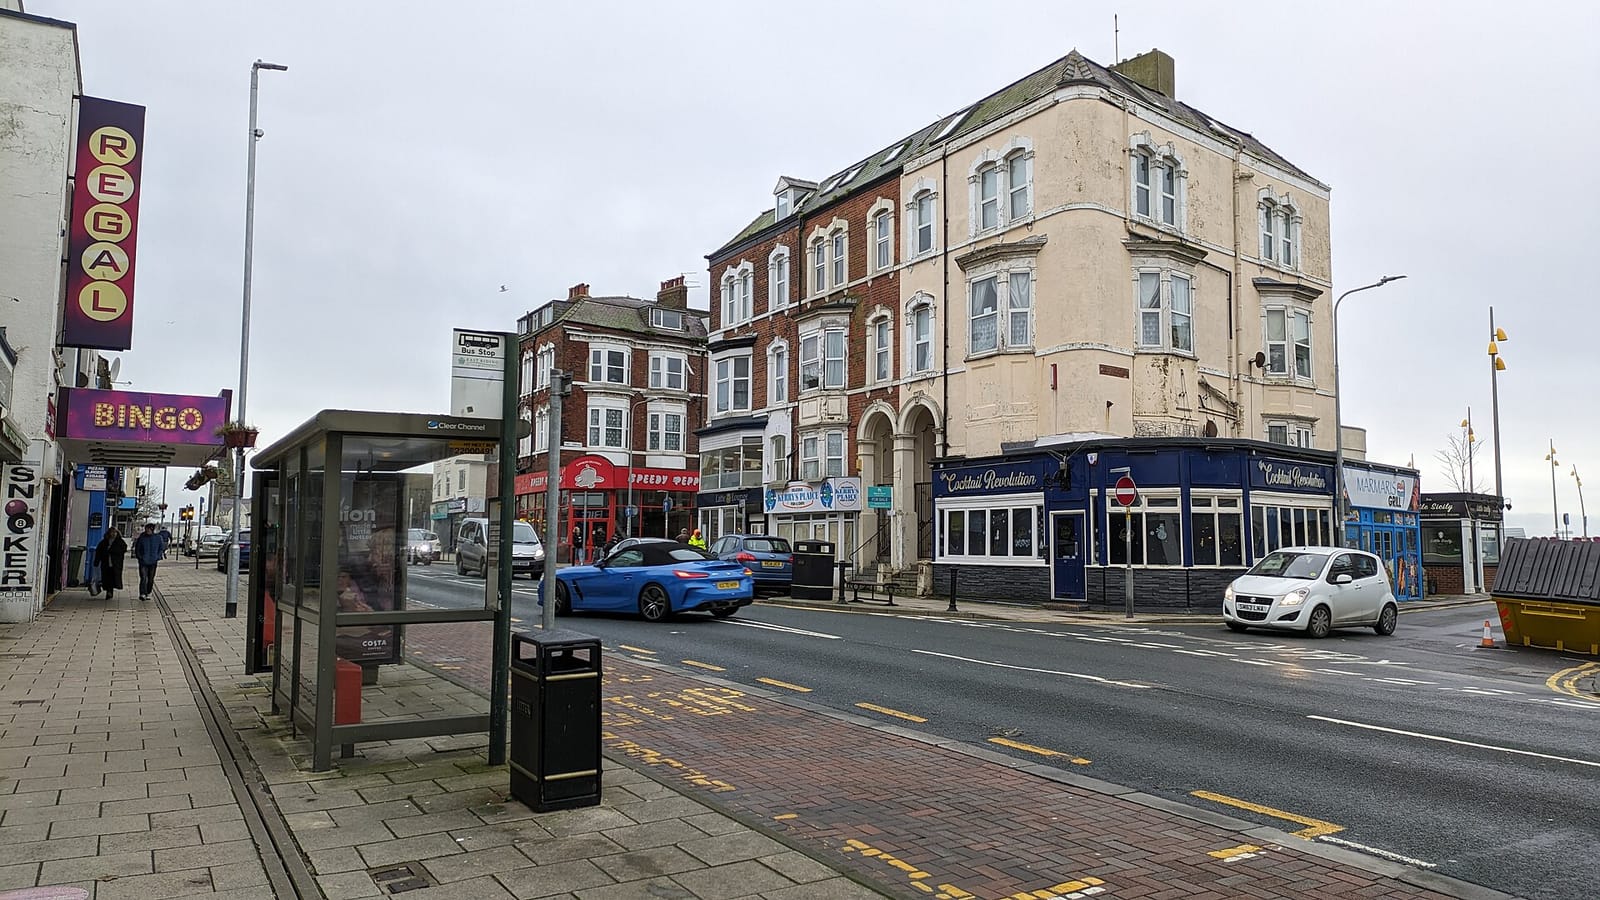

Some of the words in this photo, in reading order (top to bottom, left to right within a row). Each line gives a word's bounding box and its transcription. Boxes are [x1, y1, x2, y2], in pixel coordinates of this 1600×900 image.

[89, 134, 128, 313] REGAL
[478, 348, 496, 357] Stop
[94, 402, 203, 431] BINGO
[438, 422, 457, 430] Clear
[457, 423, 486, 431] Channel
[628, 473, 668, 485] SPEEDY
[946, 472, 983, 493] Cocktail
[984, 469, 1037, 490] Revolution
[1263, 463, 1292, 485] Cocktail
[1292, 466, 1326, 488] Revolution
[1357, 476, 1397, 495] MARMARIS
[799, 490, 819, 501] PLAICE
[1388, 495, 1402, 507] GRILL
[1430, 502, 1453, 512] Sicily
